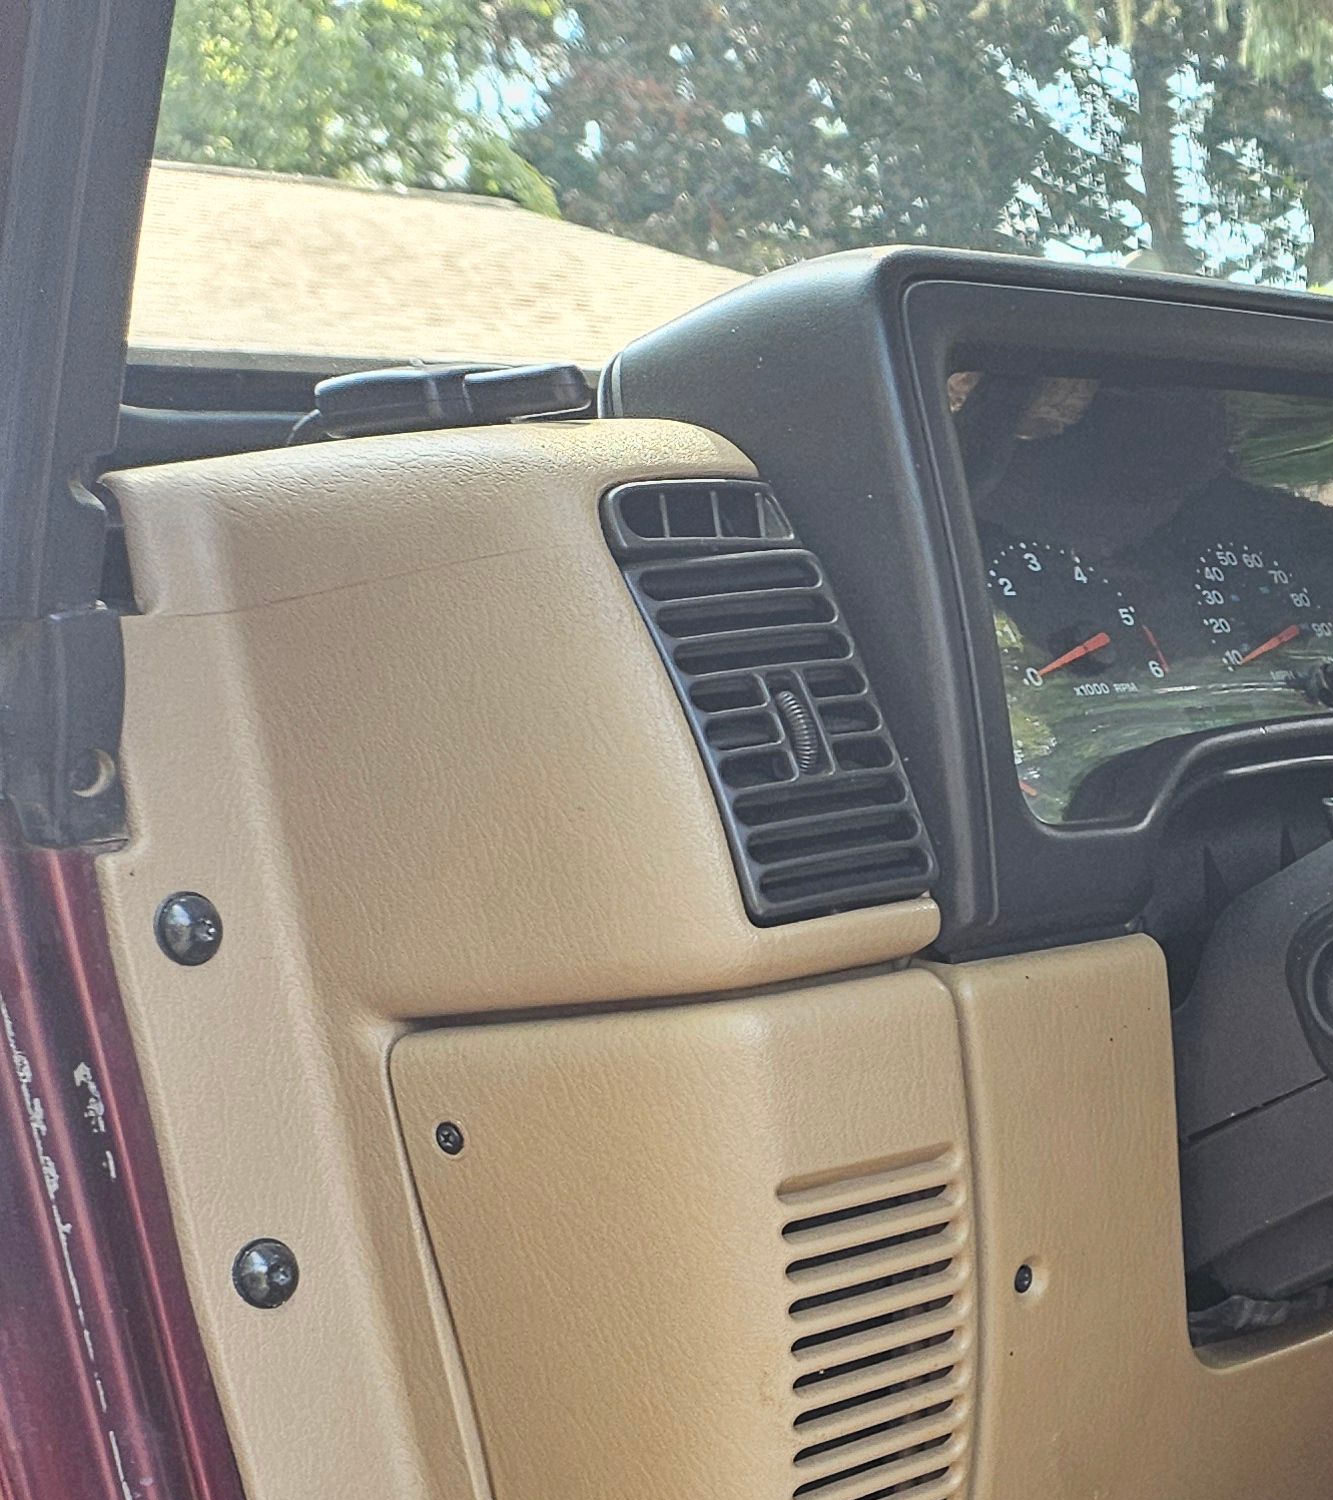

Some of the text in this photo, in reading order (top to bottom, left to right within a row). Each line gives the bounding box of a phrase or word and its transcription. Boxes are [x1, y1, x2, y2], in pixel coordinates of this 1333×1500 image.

[1023, 552, 1042, 571] 3
[1216, 551, 1237, 566] 50
[1242, 554, 1263, 568] 60
[1074, 566, 1087, 584] 4
[1204, 567, 1224, 581] 40
[1268, 570, 1288, 584] 70
[998, 578, 1017, 596] 2
[1202, 590, 1224, 605] 30
[1291, 593, 1310, 607] 80
[1118, 608, 1134, 625] 5
[1209, 618, 1230, 633] 20
[1311, 623, 1332, 637] 90
[1003, 625, 1016, 642] 1
[1225, 650, 1243, 665] 10
[1026, 667, 1043, 686] 0
[1148, 661, 1164, 678] 6
[1113, 682, 1139, 693] RPM
